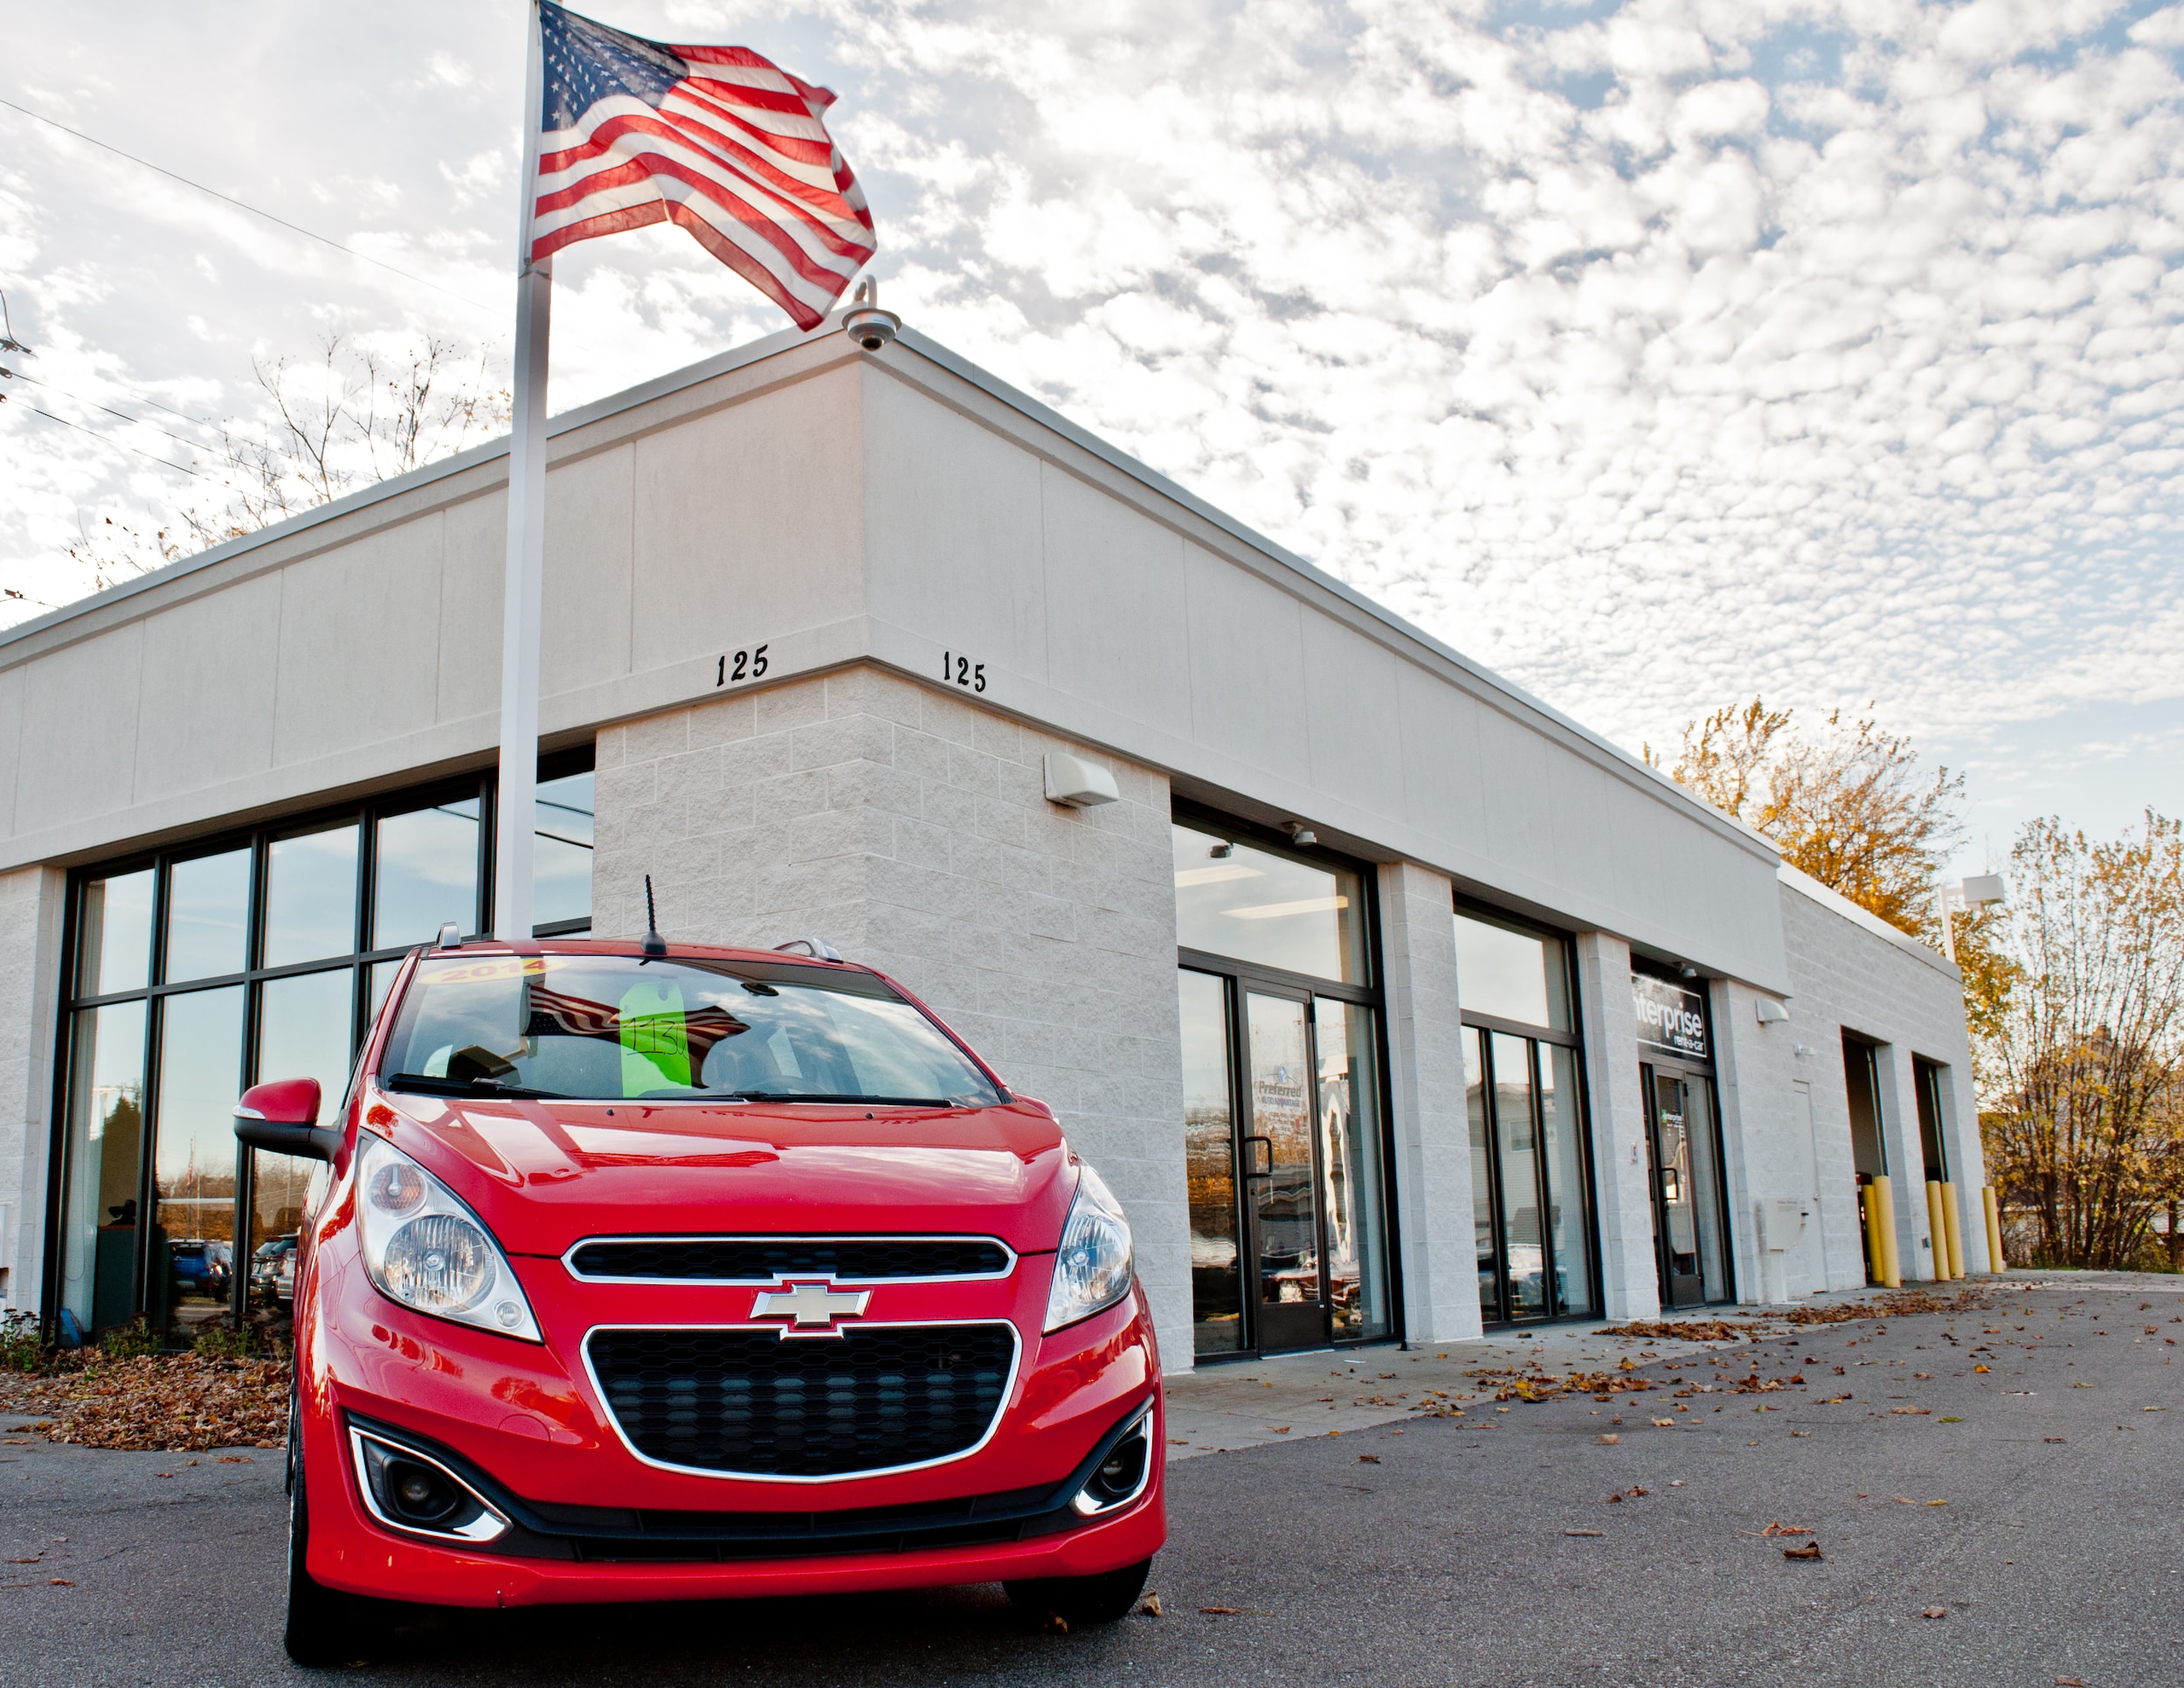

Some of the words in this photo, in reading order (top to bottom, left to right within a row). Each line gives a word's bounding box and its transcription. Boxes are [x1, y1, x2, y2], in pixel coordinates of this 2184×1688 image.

[716, 644, 769, 687] 125
[943, 651, 986, 693] 125
[440, 959, 547, 982] 2014
[1633, 993, 1703, 1038] nterprise
[1259, 1080, 1302, 1097] Preferred
